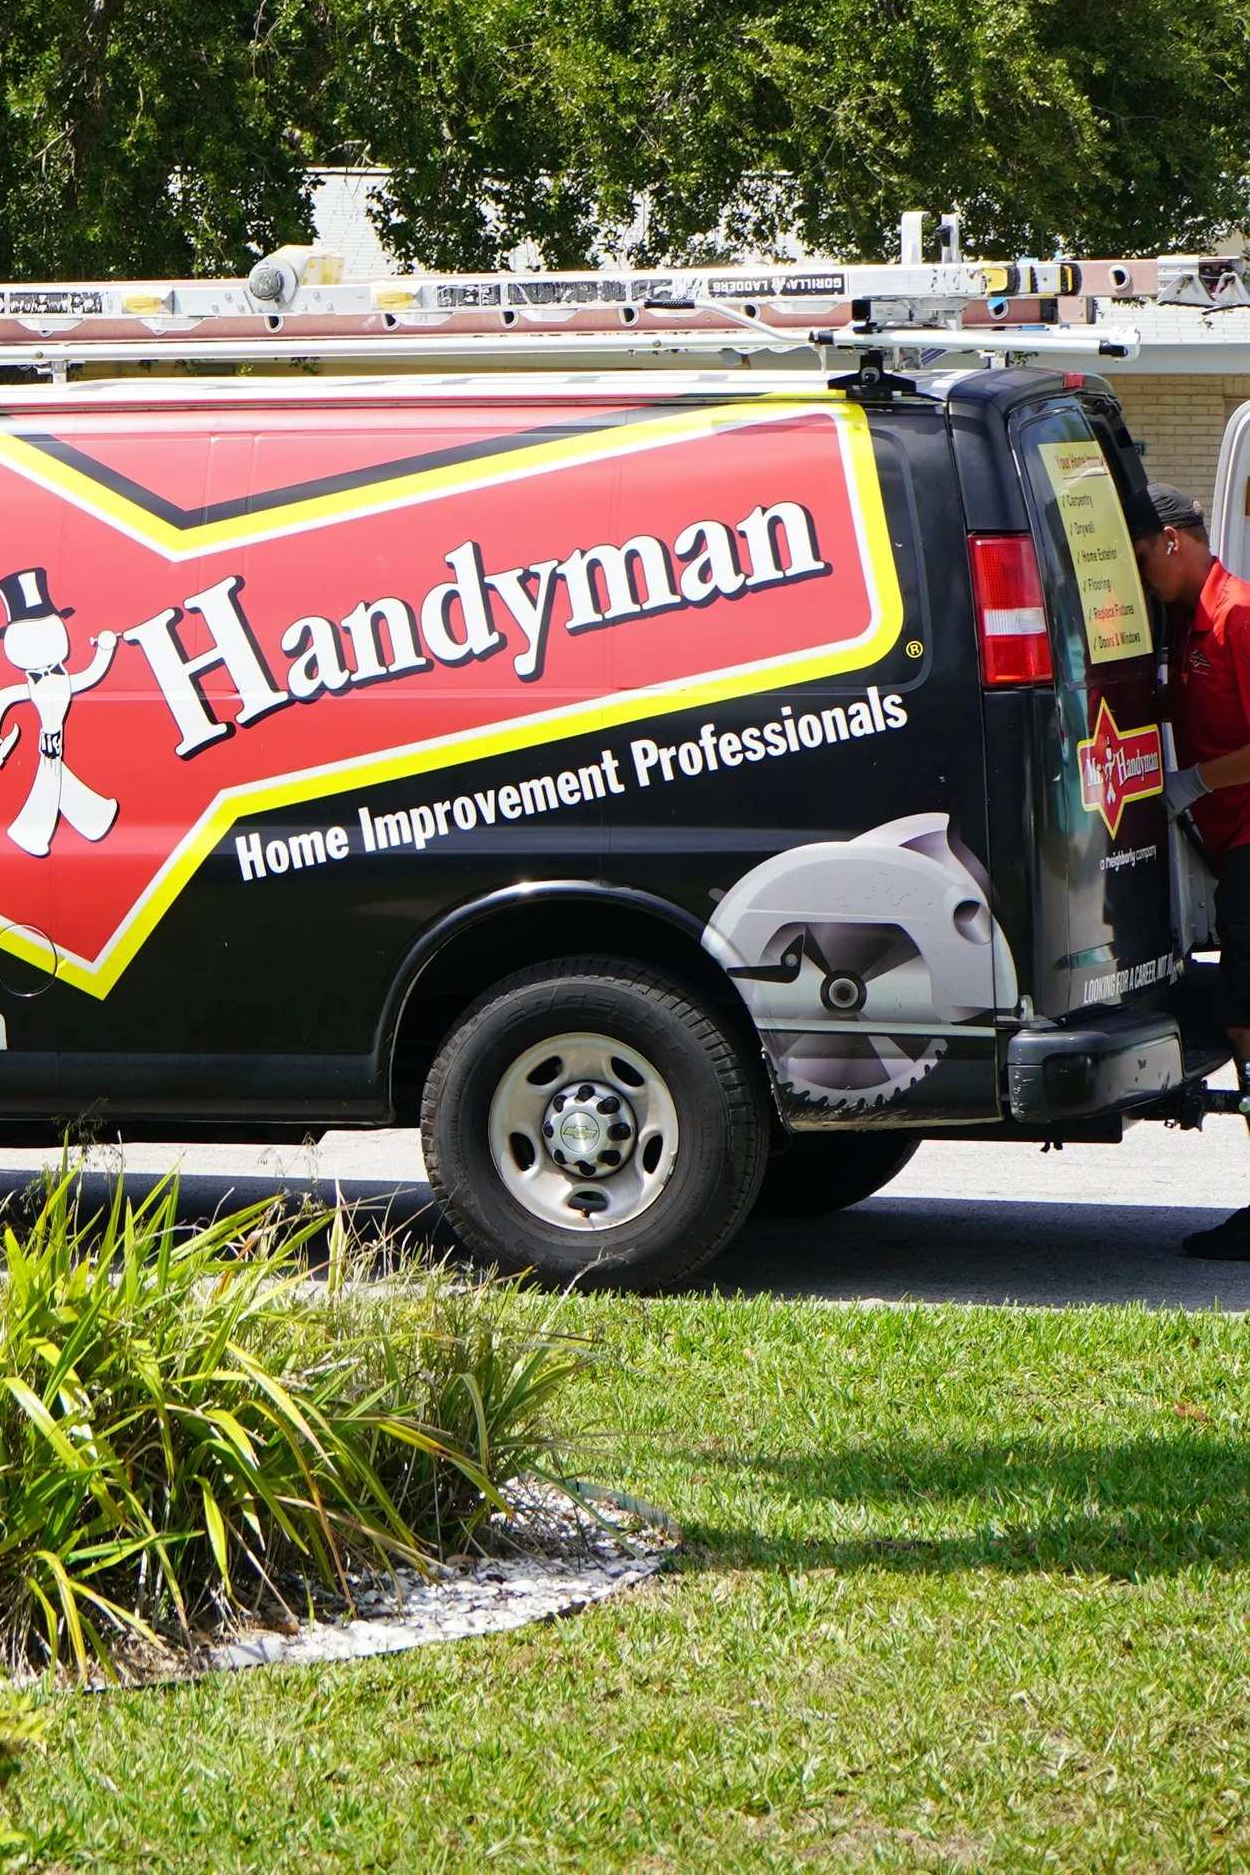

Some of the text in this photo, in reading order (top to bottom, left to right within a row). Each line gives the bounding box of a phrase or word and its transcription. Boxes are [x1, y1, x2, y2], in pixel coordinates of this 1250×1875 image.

[712, 276, 843, 293] GORILLA LADDERS
[1066, 493, 1094, 509] Carpentry
[1074, 521, 1096, 538] Drywall
[1081, 547, 1118, 563] Home Exterior
[1087, 577, 1112, 593] Flooring
[1093, 603, 1135, 622] Replace Fixtures
[123, 501, 833, 761] Handyman
[1098, 635, 1115, 650] Doors
[1120, 630, 1142, 646] Windows
[1114, 745, 1160, 787] Handyman
[234, 685, 908, 881] Home Improvement Professionals
[1105, 847, 1136, 872] neighborly
[1136, 844, 1157, 863] company
[1083, 973, 1116, 1005] LOOKING
[1115, 968, 1130, 996] FOR
[1129, 967, 1135, 991] A
